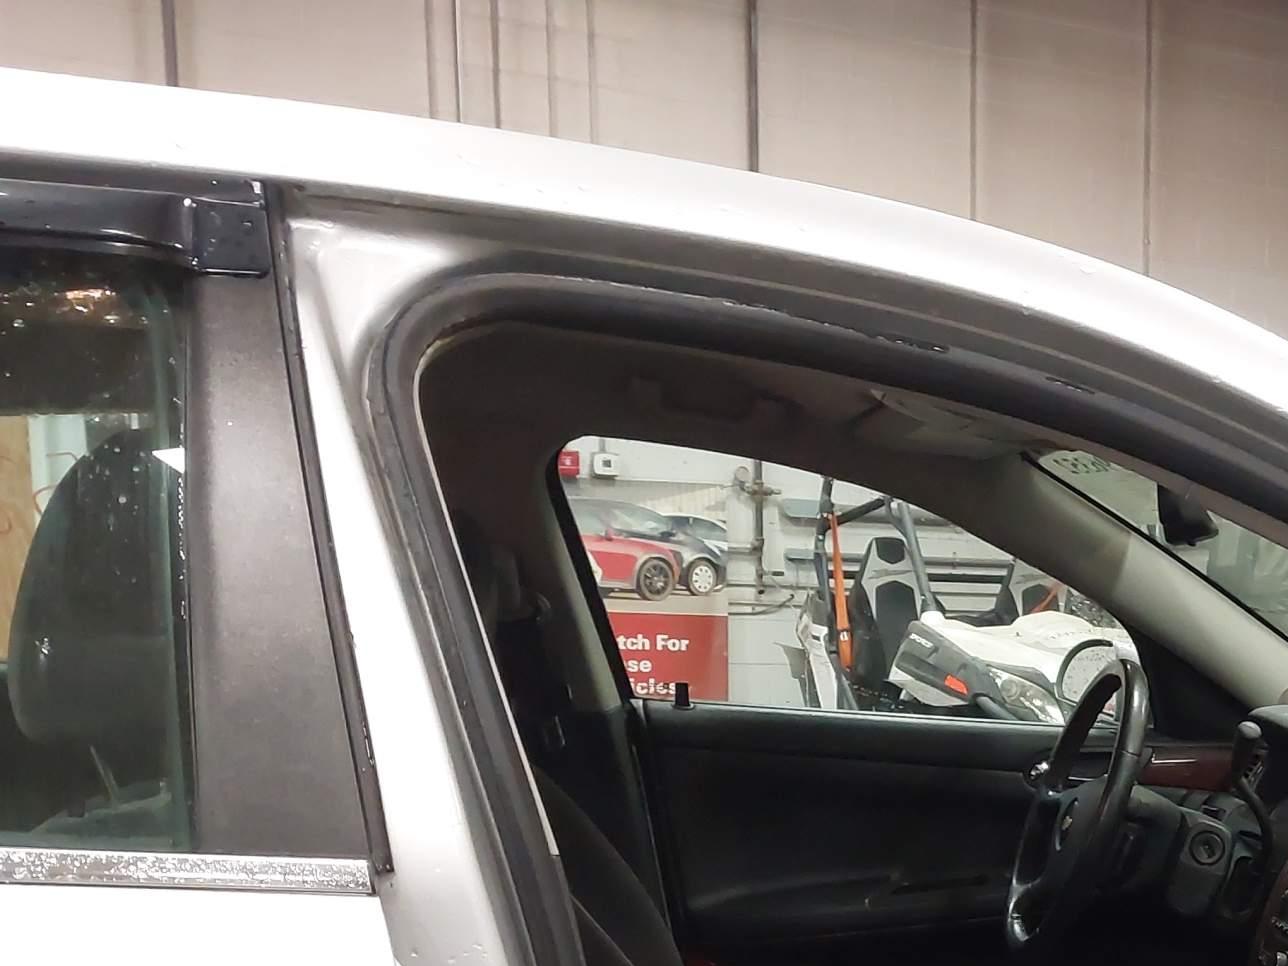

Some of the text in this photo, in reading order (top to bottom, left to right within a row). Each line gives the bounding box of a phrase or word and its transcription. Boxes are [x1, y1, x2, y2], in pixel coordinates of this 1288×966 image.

[616, 633, 690, 652] tch For
[625, 659, 653, 673] se
[629, 678, 676, 695] icles
